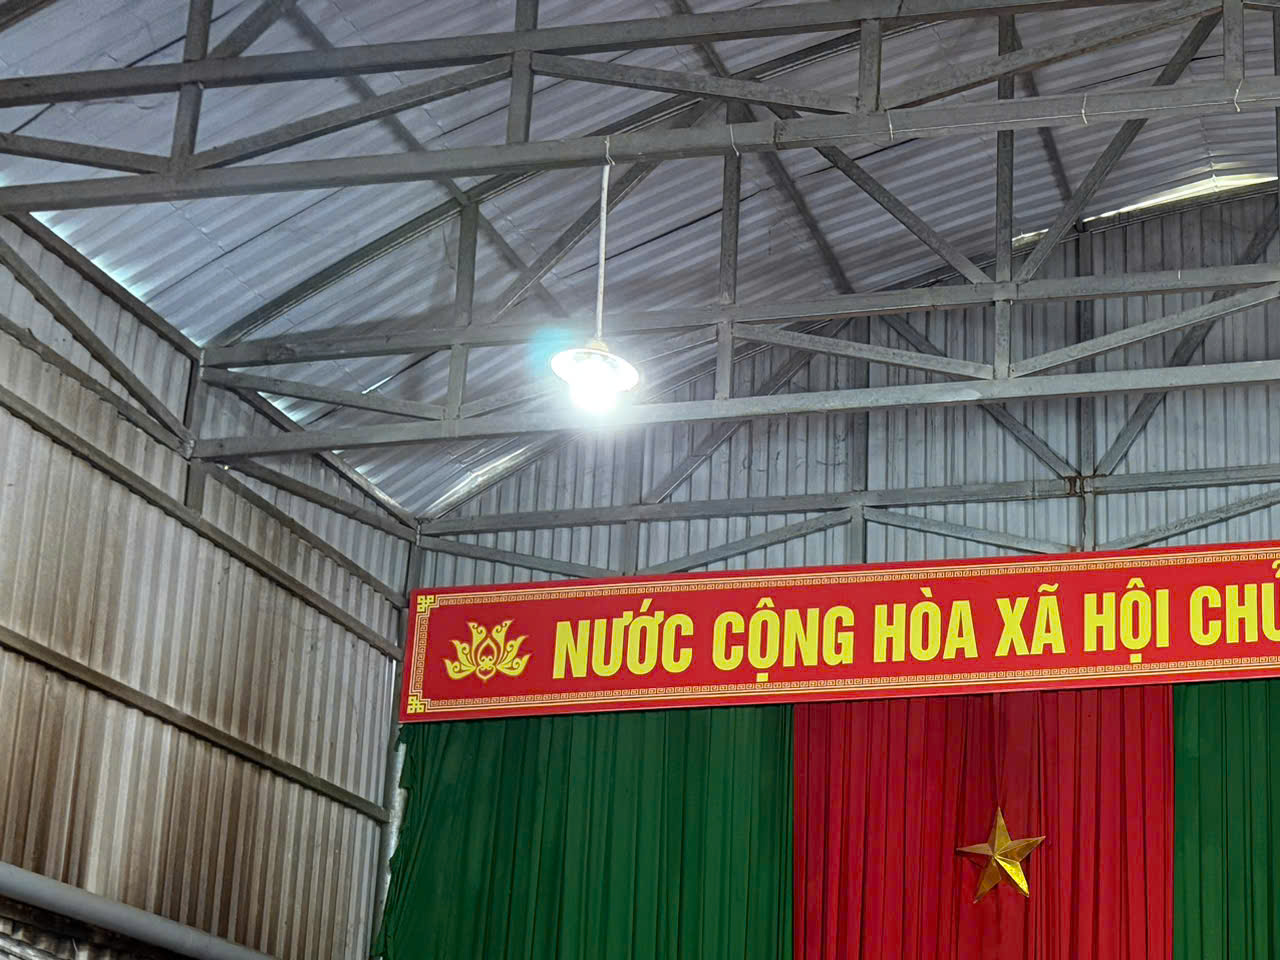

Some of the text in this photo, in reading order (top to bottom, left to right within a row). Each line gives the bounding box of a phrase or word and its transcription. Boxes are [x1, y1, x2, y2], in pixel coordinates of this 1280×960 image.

[552, 598, 693, 679] NƯỚC
[711, 597, 854, 683] CỘNG
[874, 588, 978, 662] HÒA
[995, 583, 1066, 656] XÃ
[1084, 577, 1171, 664] HỘI
